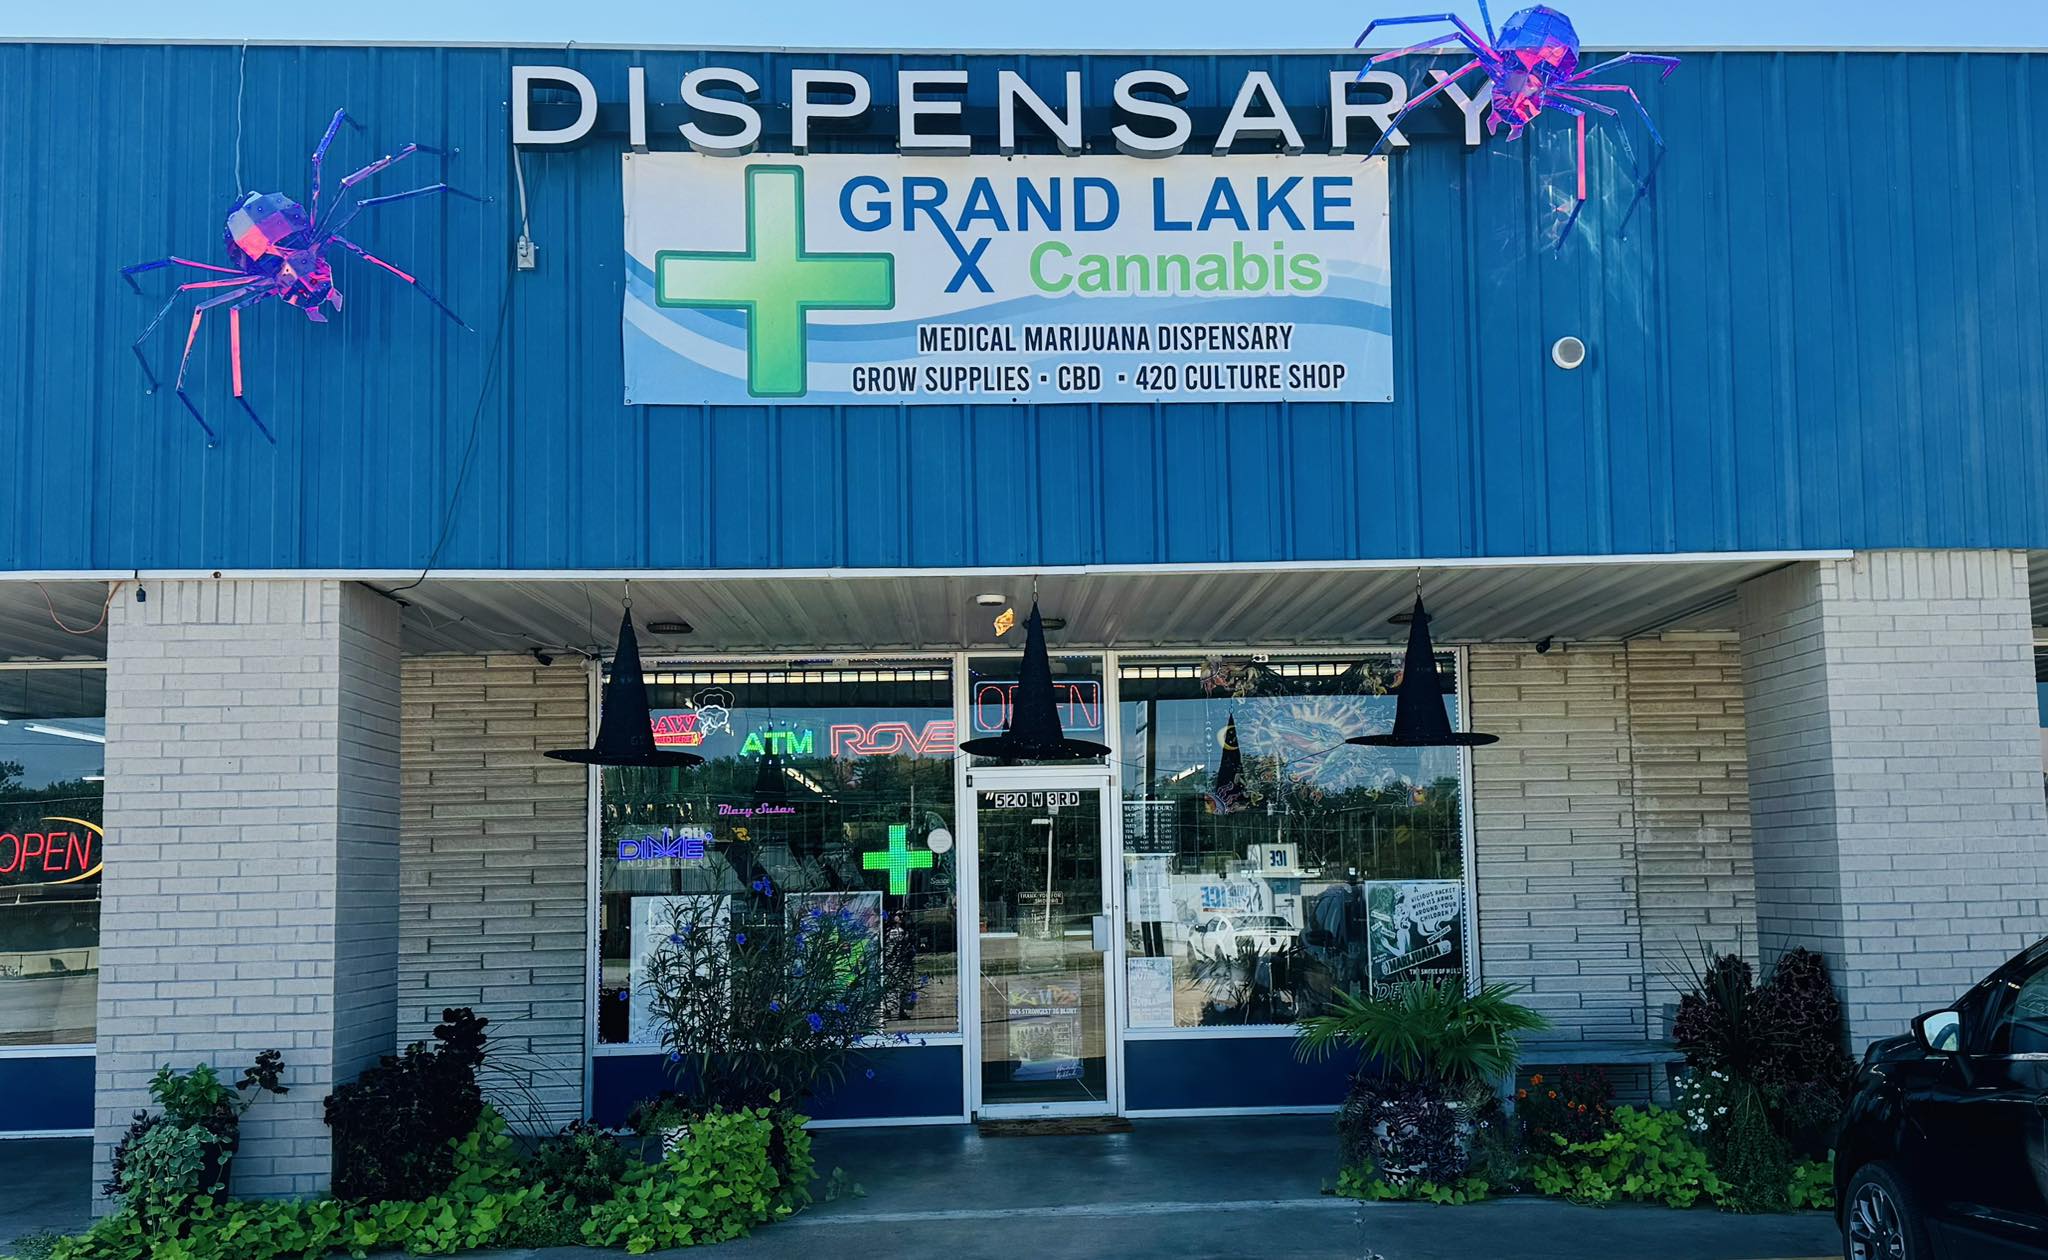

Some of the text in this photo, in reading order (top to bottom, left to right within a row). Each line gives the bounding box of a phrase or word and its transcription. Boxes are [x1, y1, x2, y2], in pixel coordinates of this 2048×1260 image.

[512, 66, 1492, 148] DISPENSARY
[839, 175, 1355, 232] GRAND LAKE
[1030, 241, 1323, 293] Cannabis
[919, 325, 1293, 352] MEDICAL MARIJUANA DISPENSARY
[852, 364, 1346, 392] GROW SUPPLIES CBD 420 CULTURE SHOP
[740, 729, 813, 756] ATM
[830, 721, 956, 757] ROVE
[718, 803, 796, 818] Blazy Susan
[995, 791, 1080, 807] 520 W 3RD
[0, 832, 92, 873] OPEN
[619, 828, 704, 861] DIME
[1389, 942, 1442, 974] MARIJUANA
